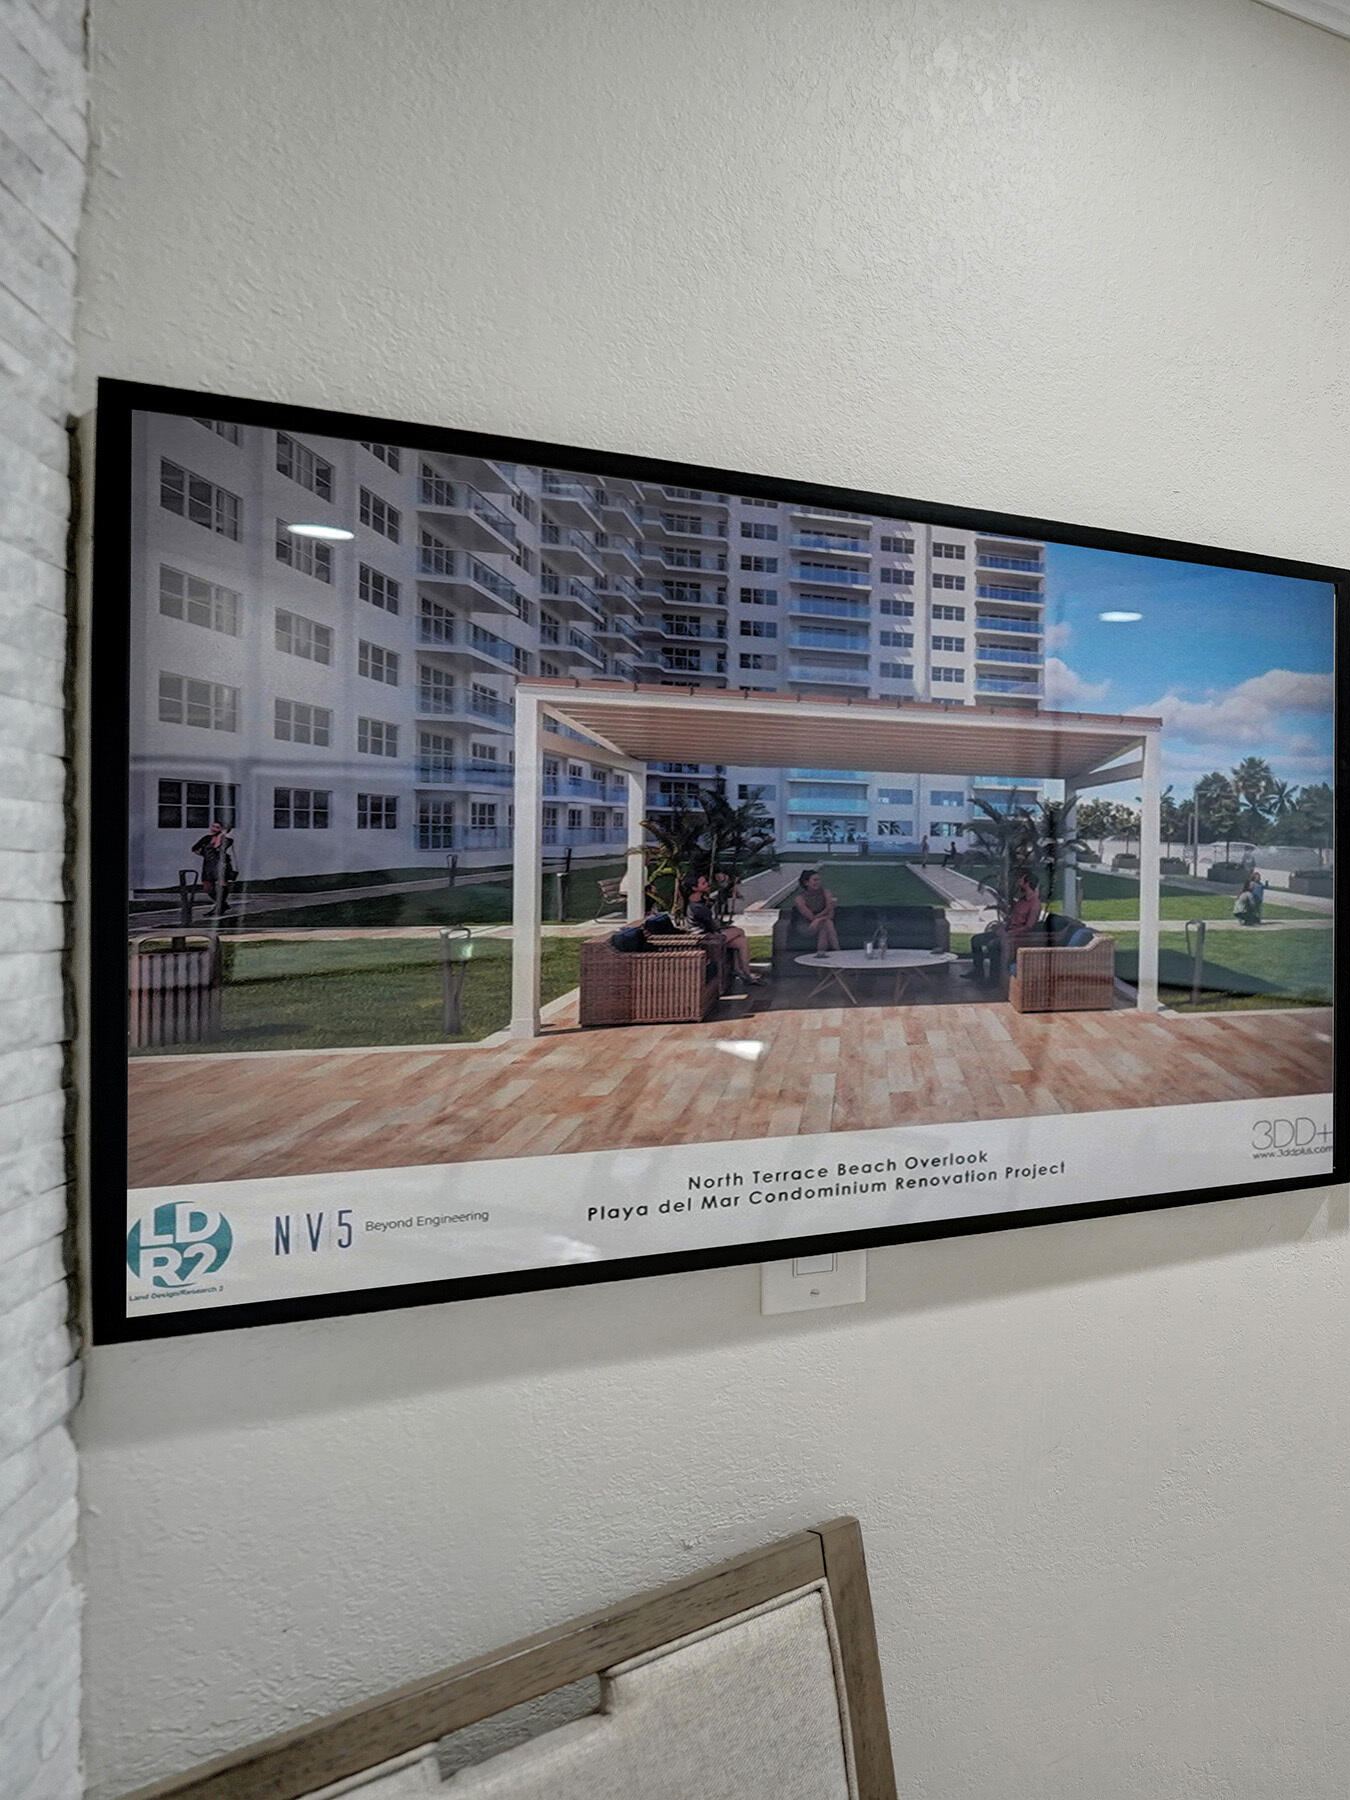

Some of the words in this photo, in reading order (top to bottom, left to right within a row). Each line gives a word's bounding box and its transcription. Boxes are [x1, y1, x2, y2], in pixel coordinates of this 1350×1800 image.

[588, 1205, 648, 1221] Playa
[659, 1197, 691, 1214] del
[701, 1195, 740, 1210] Mar
[749, 1181, 886, 1204] Condominium
[896, 1169, 997, 1190] Renovation
[1005, 1161, 1065, 1179] Project
[689, 1172, 743, 1190] North
[752, 1168, 828, 1184] Terrace
[838, 1159, 897, 1176] Beach
[905, 1151, 988, 1170] Overlook
[138, 1203, 221, 1247] LD
[275, 1209, 353, 1256] NV5
[365, 1217, 413, 1232] Beyond
[416, 1211, 489, 1228] Engineering
[138, 1243, 218, 1287] R2
